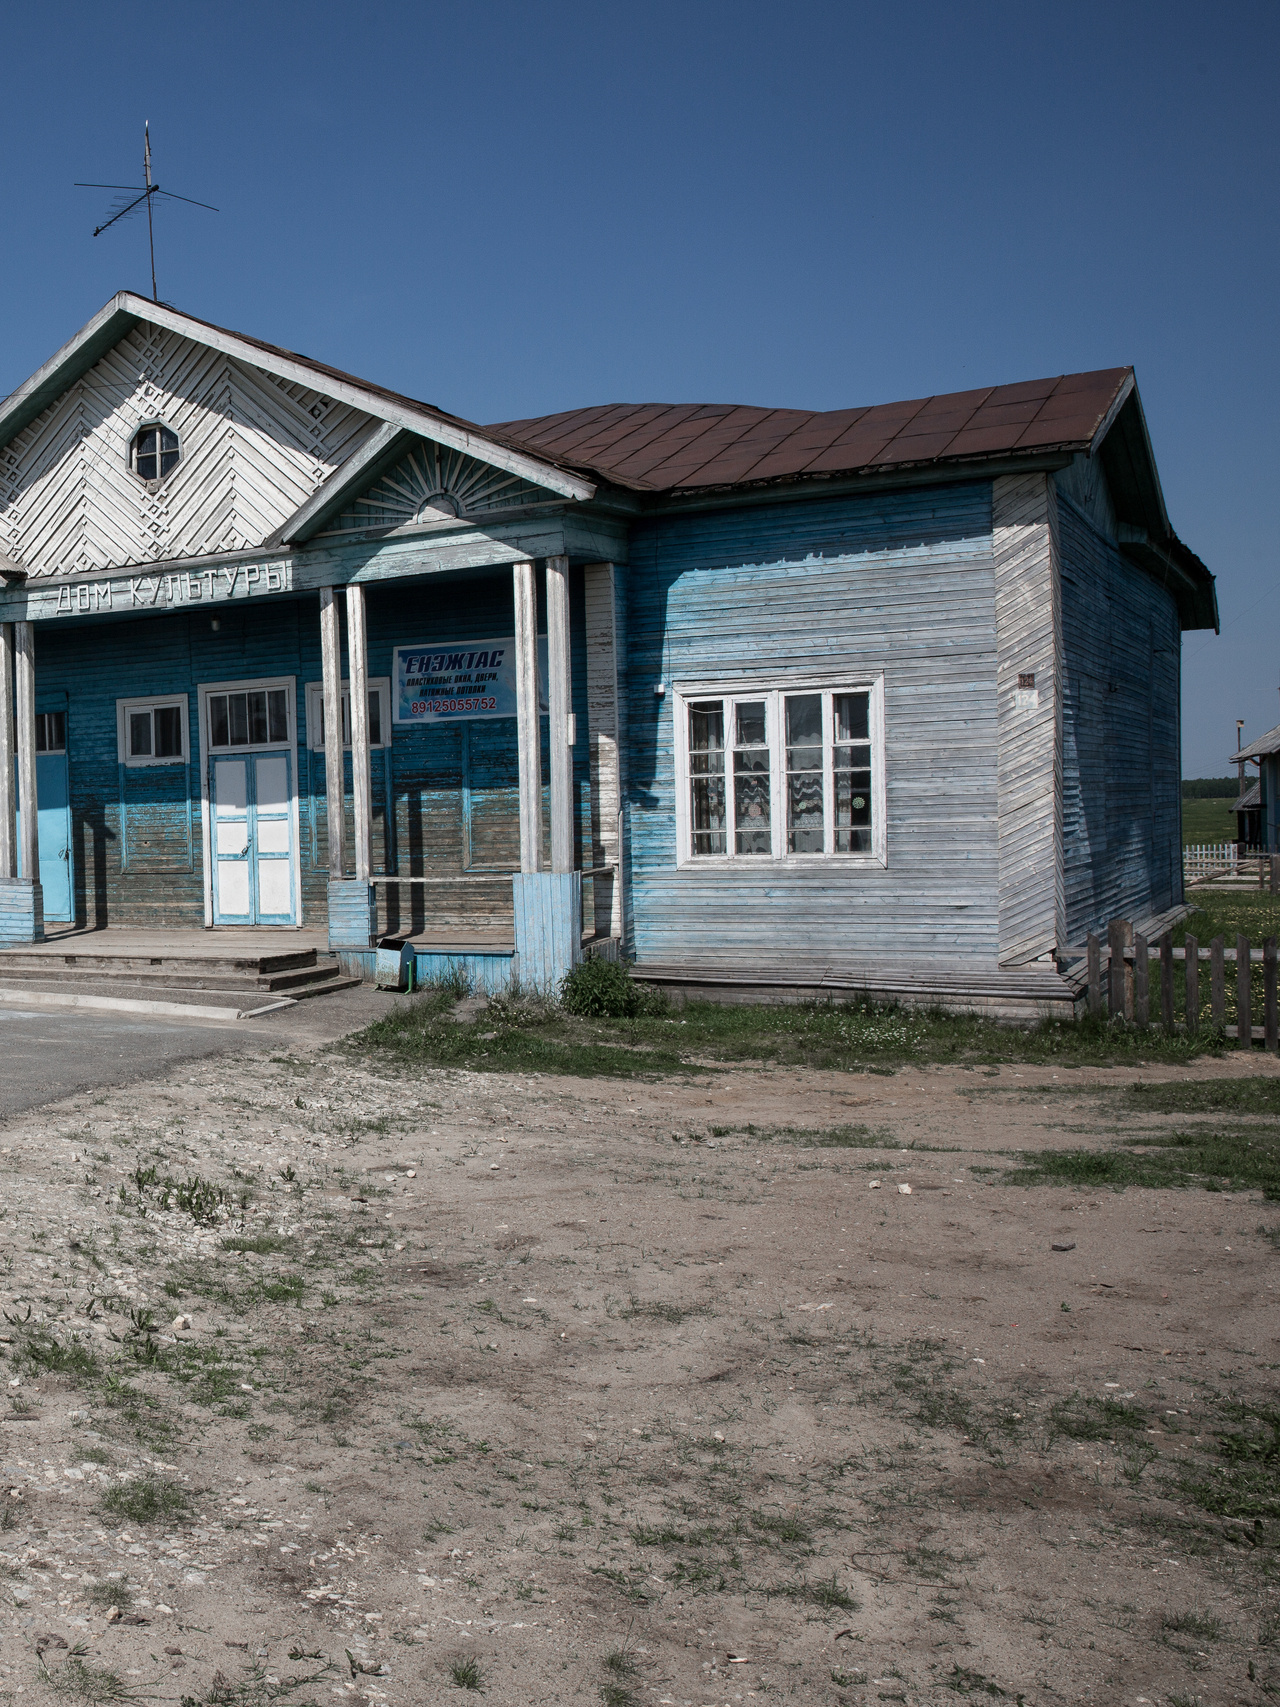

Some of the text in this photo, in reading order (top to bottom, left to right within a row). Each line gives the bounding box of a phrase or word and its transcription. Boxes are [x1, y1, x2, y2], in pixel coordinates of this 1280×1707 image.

[56, 560, 288, 615] ДОМ КУЛЬТУРЫ
[405, 650, 505, 674] ЕНЭЖТАС
[406, 672, 499, 686] ПЛАСТИКОВЫЕ ОКНА, ДВЕРИ,
[419, 684, 487, 697] НАТЯЖНЫЕ ПОТОЛКИ
[411, 697, 497, 714] 89125055752
